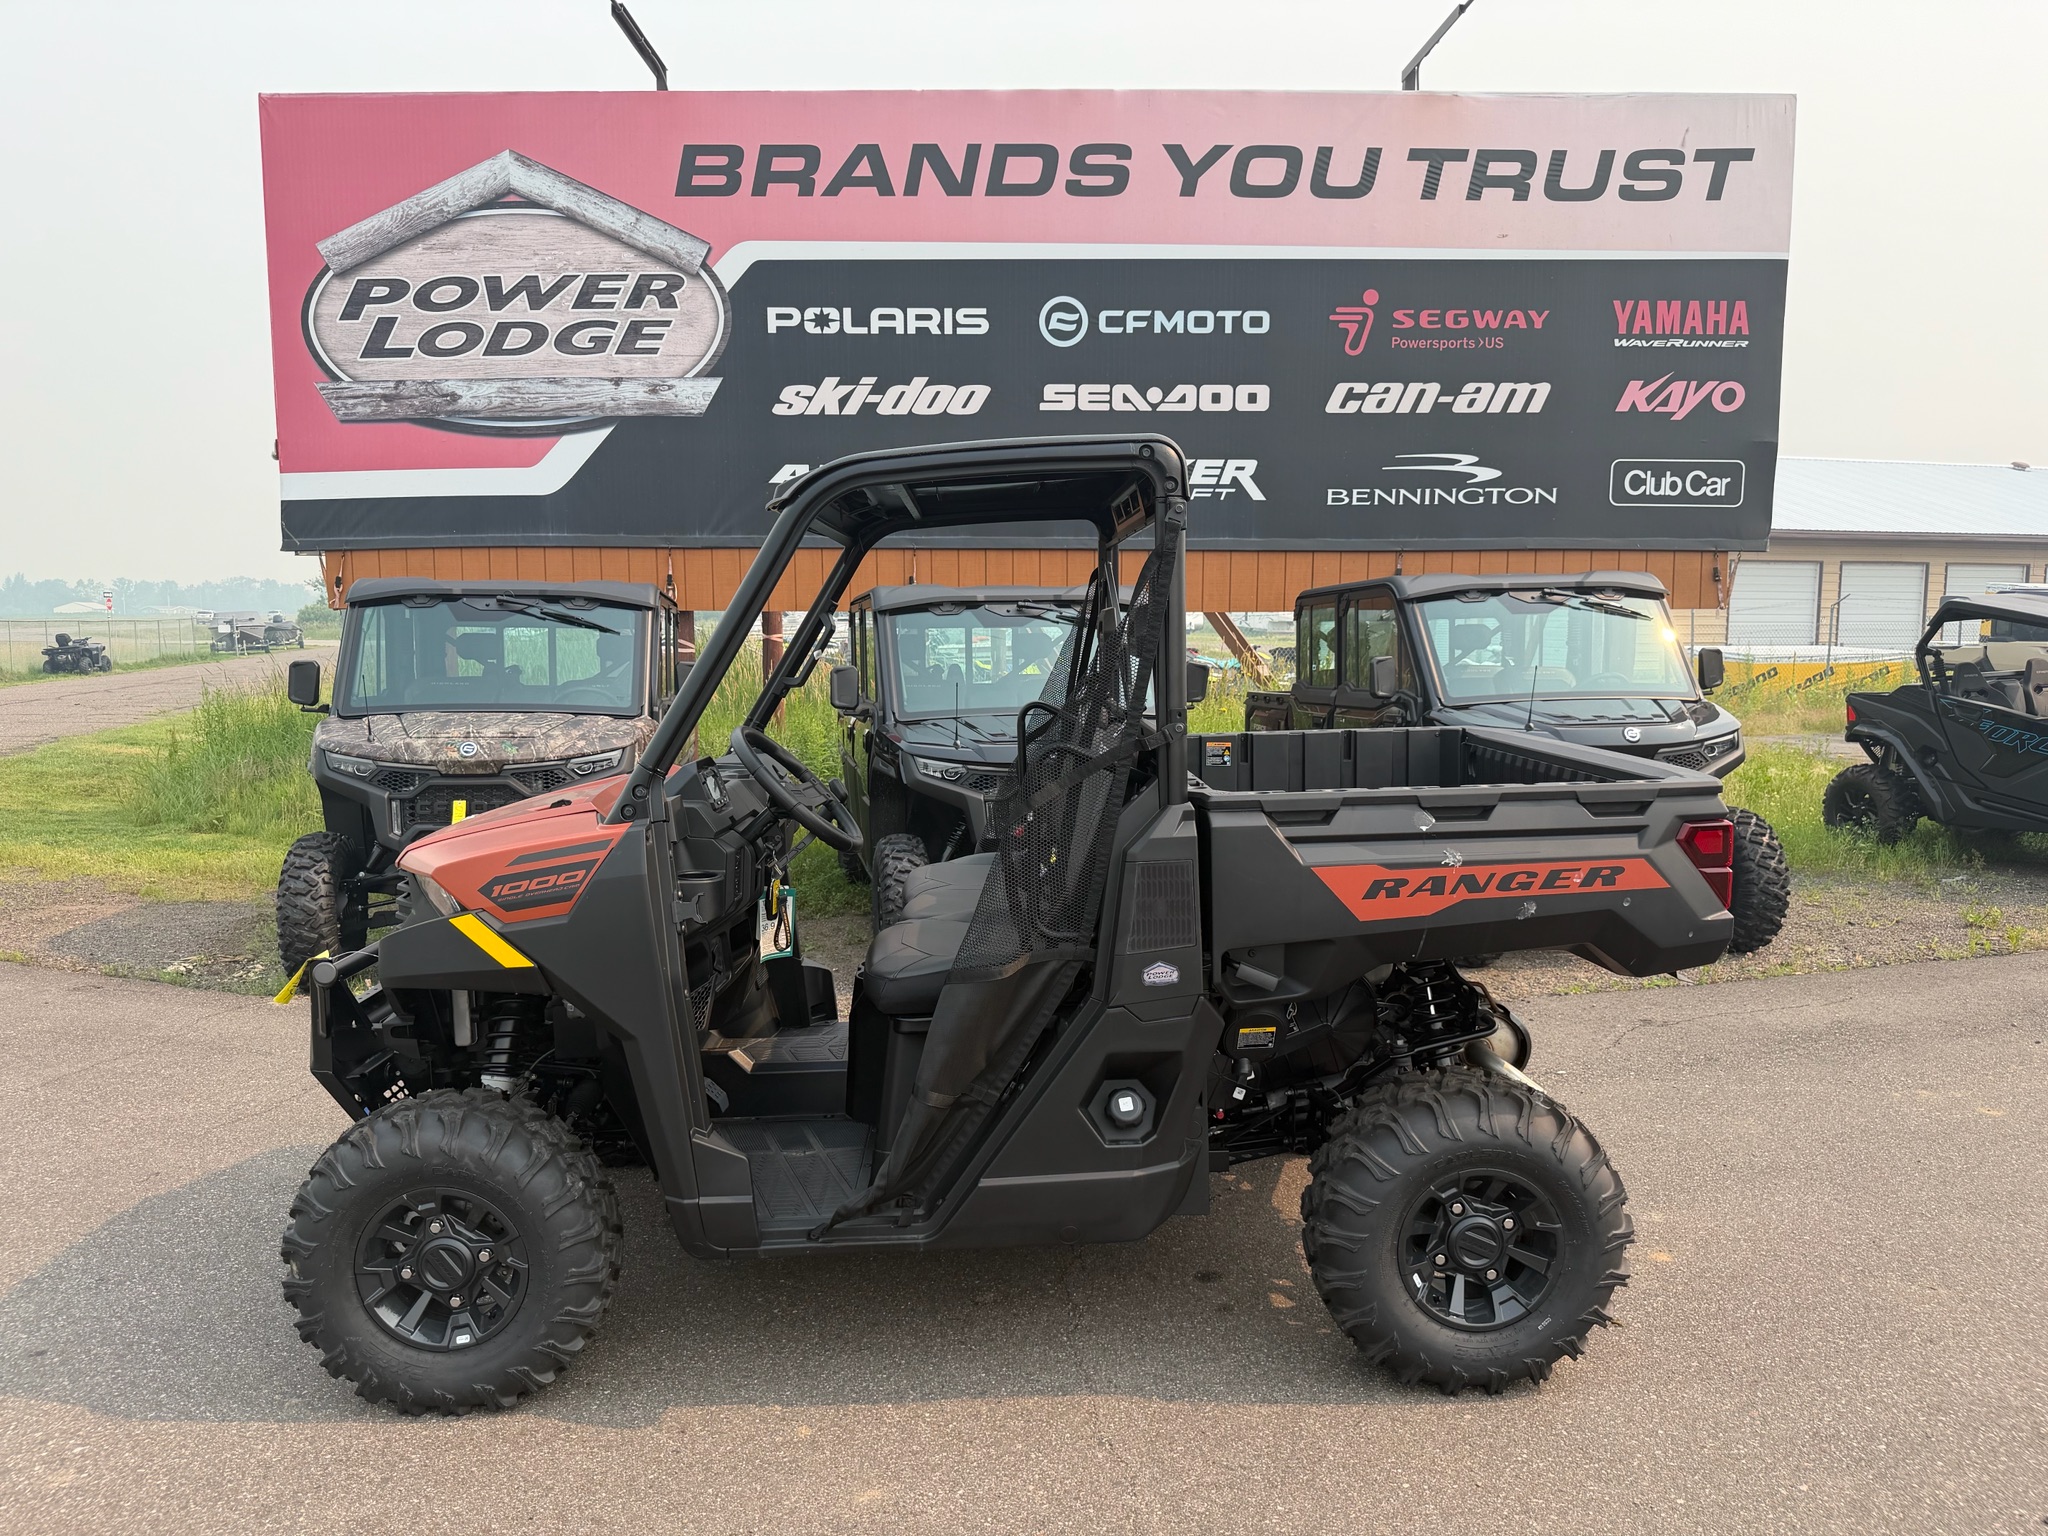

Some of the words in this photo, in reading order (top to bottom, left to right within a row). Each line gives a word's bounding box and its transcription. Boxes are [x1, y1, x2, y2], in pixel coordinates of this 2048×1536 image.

[675, 143, 1132, 198] BRANDS
[1162, 143, 1382, 200] YOU
[1407, 147, 1755, 202] TRUST
[337, 272, 687, 322] POWER
[766, 306, 990, 335] POLARIS
[1098, 309, 1271, 334] CFMOTO
[1392, 309, 1550, 329] SEGWAY
[1613, 299, 1750, 335] YAMAHA
[357, 315, 675, 360] LODGE
[771, 376, 992, 416] ski-doo
[1324, 381, 1552, 414] can-am
[1614, 371, 1746, 421] KAYO
[1185, 459, 1267, 501] ER
[1326, 487, 1558, 506] BENNINGTON
[1624, 469, 1683, 497] Club
[1685, 470, 1732, 497] Car
[415, 800, 516, 815] CFOT
[490, 869, 587, 898] 1000
[1361, 865, 1626, 901] RANGER
